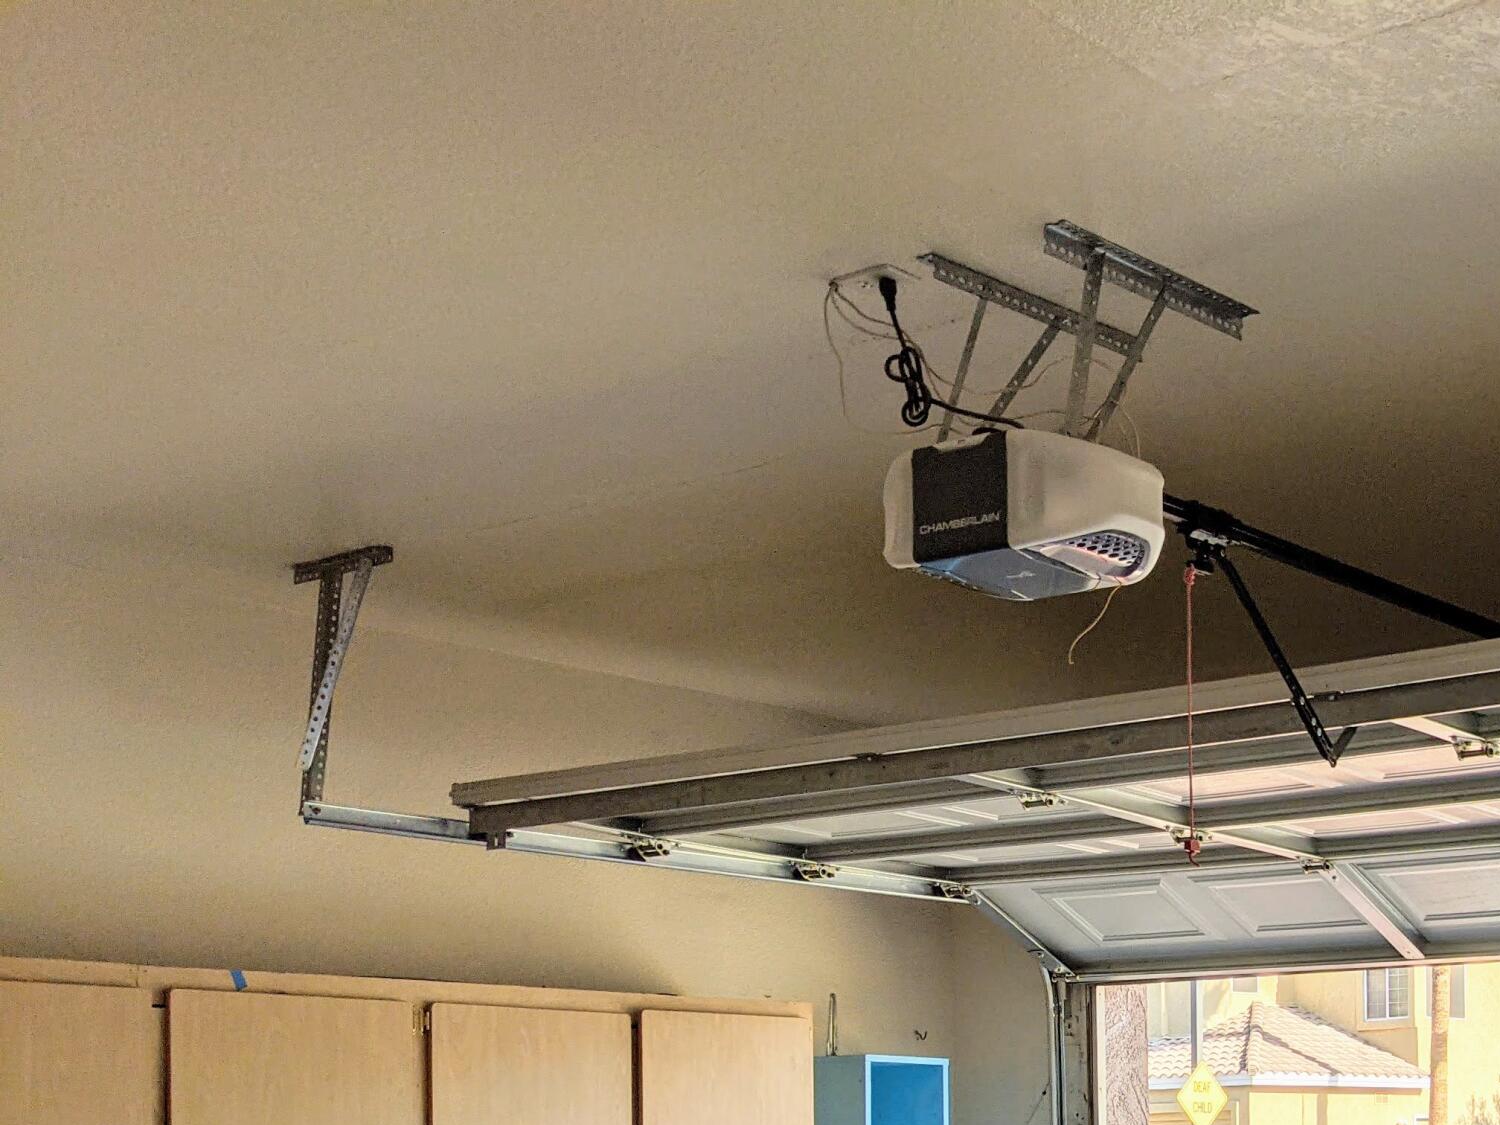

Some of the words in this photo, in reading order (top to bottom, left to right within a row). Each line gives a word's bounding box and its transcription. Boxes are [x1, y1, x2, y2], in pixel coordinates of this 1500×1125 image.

[919, 512, 1000, 535] CHAMBERLAIN
[1193, 1081, 1211, 1093] DEAF
[1193, 1102, 1213, 1114] CHILD
